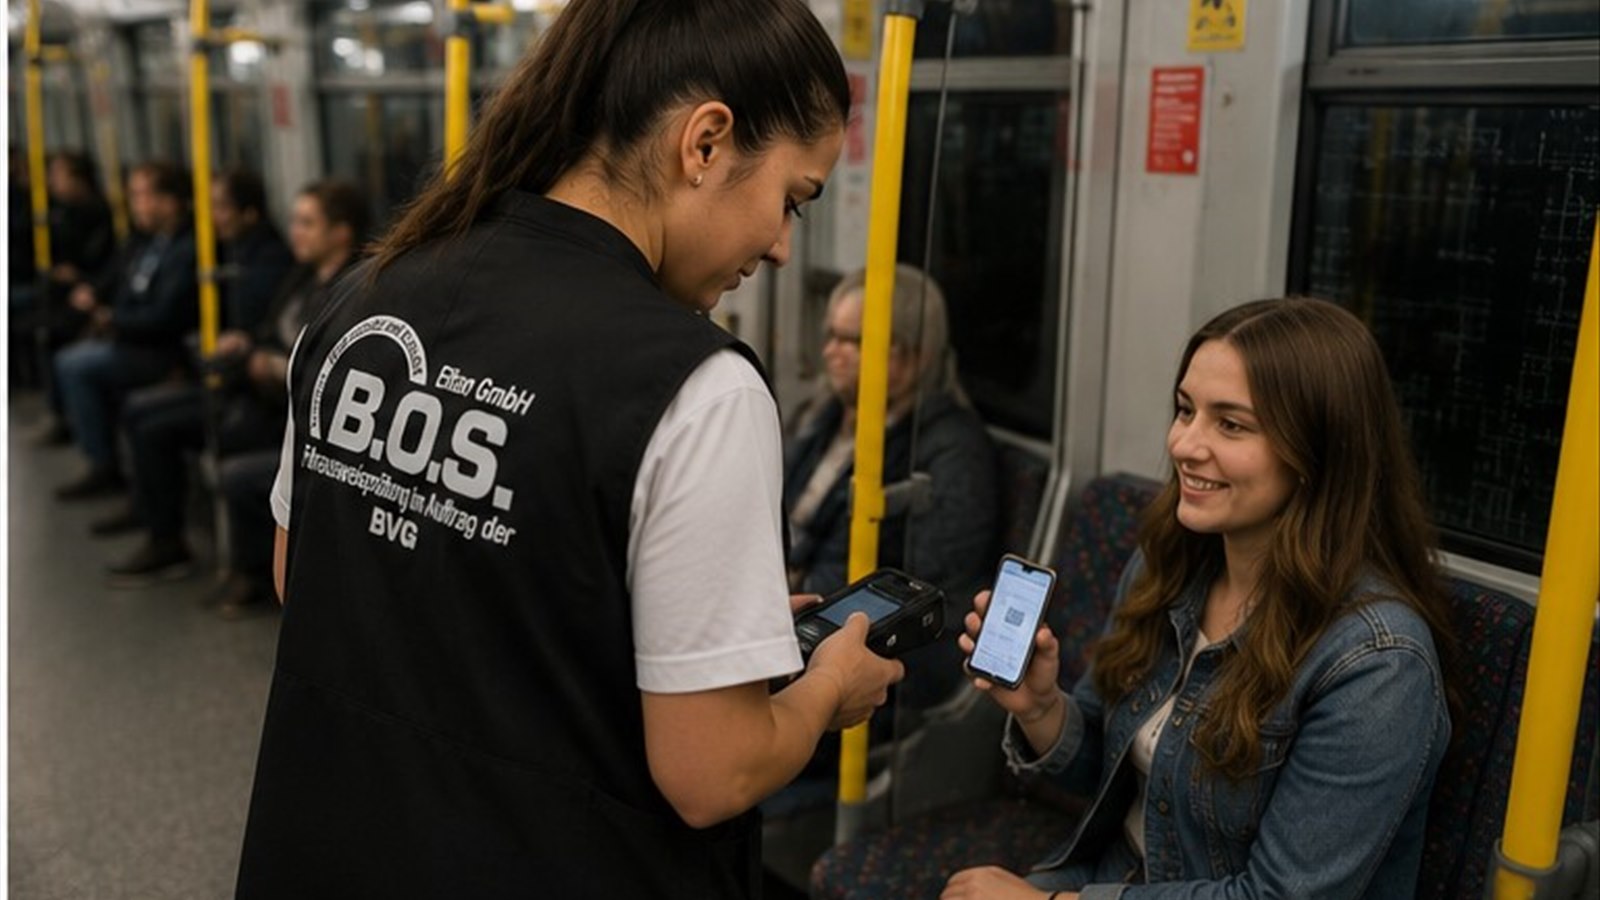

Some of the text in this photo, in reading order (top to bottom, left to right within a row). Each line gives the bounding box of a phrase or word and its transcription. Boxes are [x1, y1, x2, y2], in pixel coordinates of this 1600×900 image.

[475, 378, 535, 415] GmbH
[327, 368, 513, 511] B.O.S.
[369, 507, 418, 549] BVG
[424, 493, 478, 540] Auftrag
[481, 516, 516, 546] der
